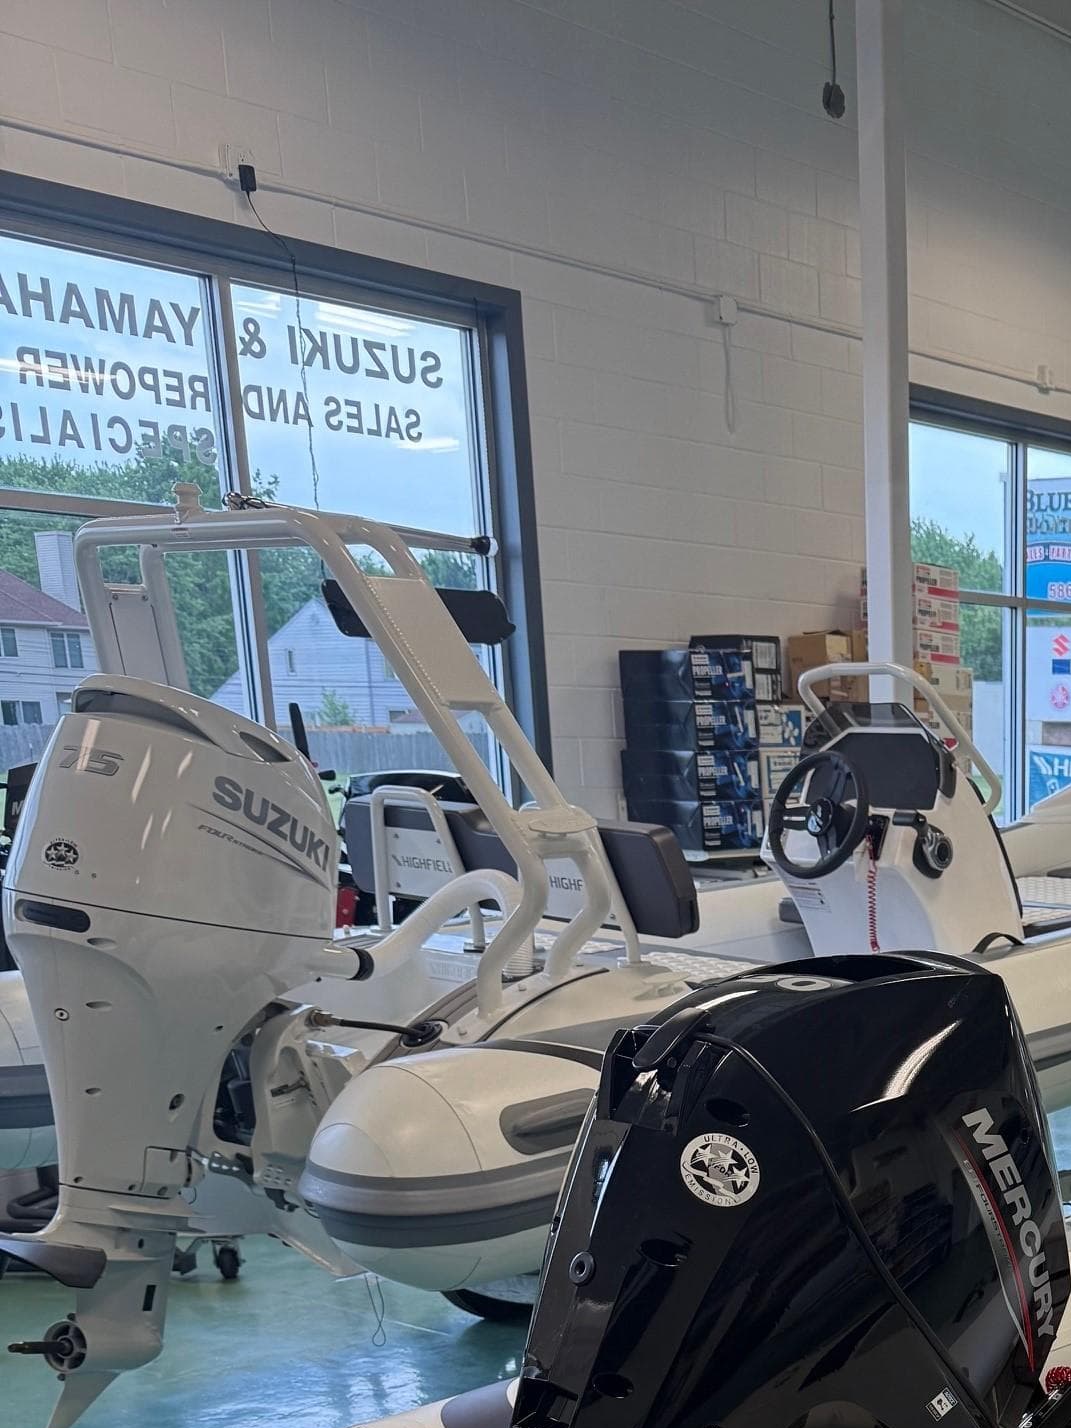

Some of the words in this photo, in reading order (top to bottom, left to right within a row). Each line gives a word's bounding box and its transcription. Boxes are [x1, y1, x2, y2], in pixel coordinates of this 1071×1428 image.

[212, 775, 330, 872] SUZUKI
[703, 1134, 738, 1149] ULTRA
[743, 1151, 759, 1174] LOW
[962, 1107, 1054, 1338] MERCURY
